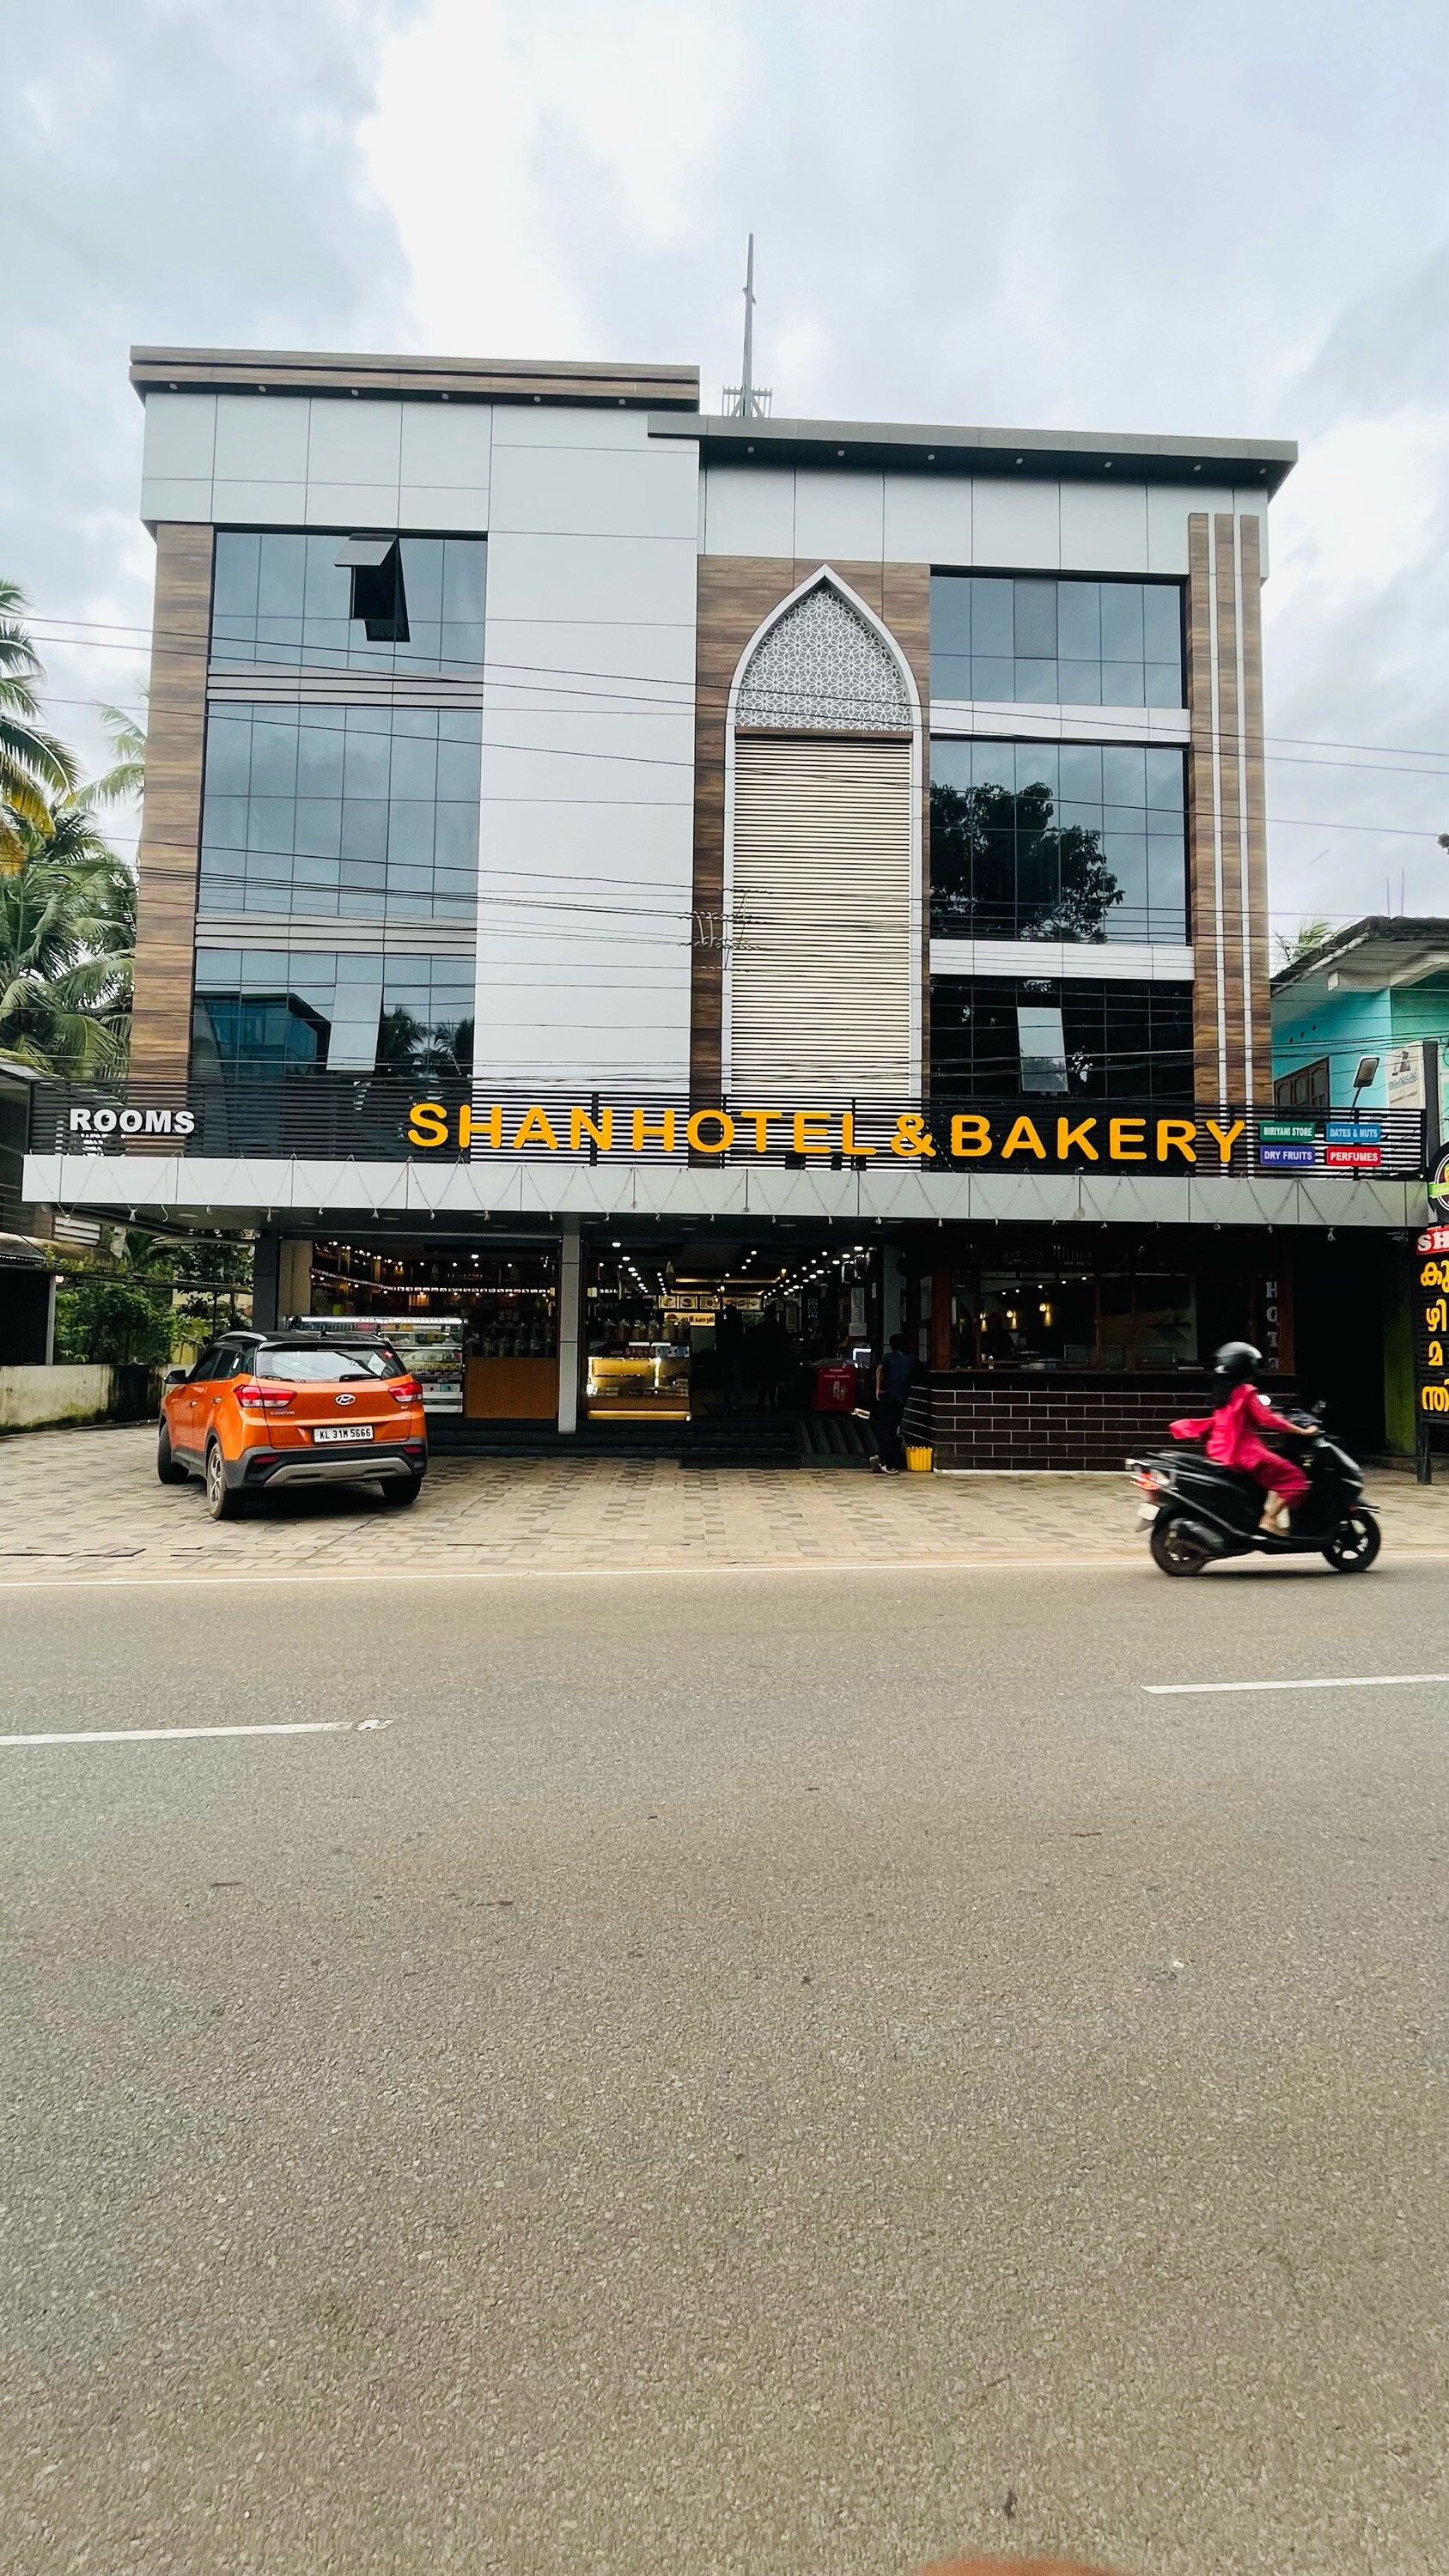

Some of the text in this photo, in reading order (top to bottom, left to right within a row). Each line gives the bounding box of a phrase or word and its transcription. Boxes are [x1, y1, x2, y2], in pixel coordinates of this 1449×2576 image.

[70, 1109, 196, 1134] ROOMS
[407, 1103, 1245, 1163] SHAN HOTEL & BAKERY
[1263, 1127, 1312, 1137] BIRIYANI STORE
[1330, 1128, 1378, 1138] DATES & NUTS
[1263, 1151, 1313, 1161] DRY FRUITS
[1330, 1151, 1379, 1162] PERFUMES
[320, 1431, 330, 1439] KL
[350, 1428, 371, 1437] 5666
